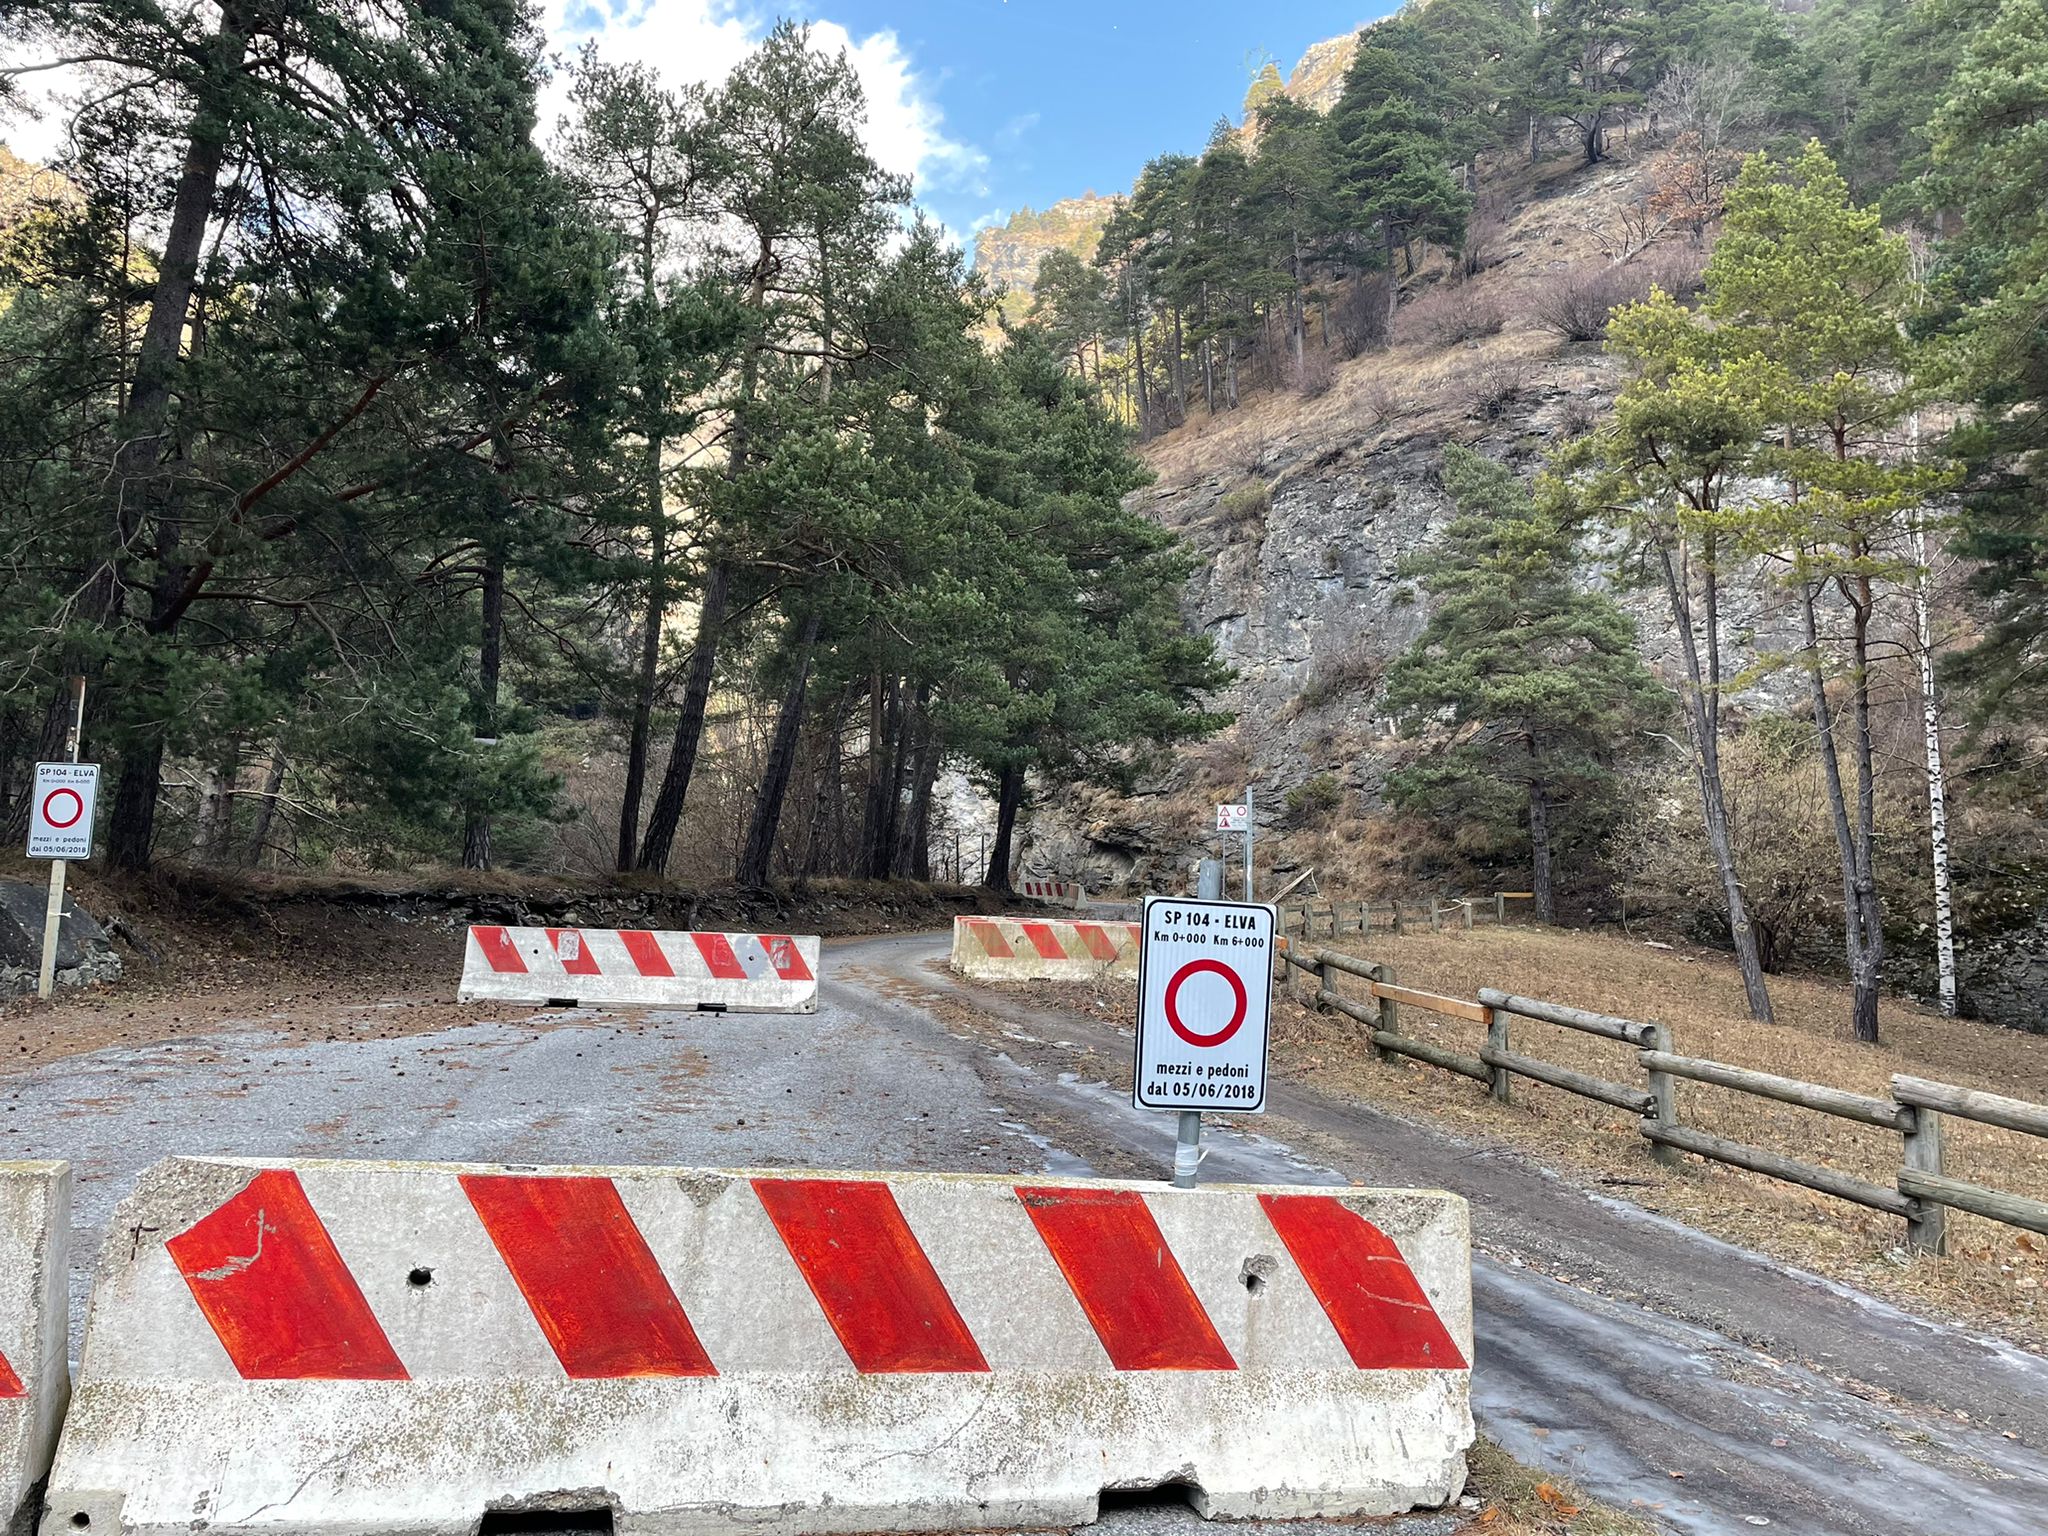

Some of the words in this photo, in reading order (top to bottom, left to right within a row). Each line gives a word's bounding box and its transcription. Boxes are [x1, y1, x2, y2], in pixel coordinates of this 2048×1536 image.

[52, 768, 67, 776] 104
[74, 769, 95, 777] ELVA
[1164, 910, 1182, 926] SP
[1186, 912, 1210, 927] 104
[1224, 915, 1256, 930] ELVA
[1154, 931, 1169, 942] Km
[1172, 932, 1206, 944] 0+000
[1213, 934, 1229, 946] Km
[1231, 935, 1264, 948] 6+000
[1156, 1061, 1192, 1075] mezzi
[1196, 1065, 1204, 1076] e
[1207, 1063, 1249, 1080] pedoni
[1147, 1081, 1168, 1096] dal
[1173, 1082, 1255, 1099] 05/06/2018
